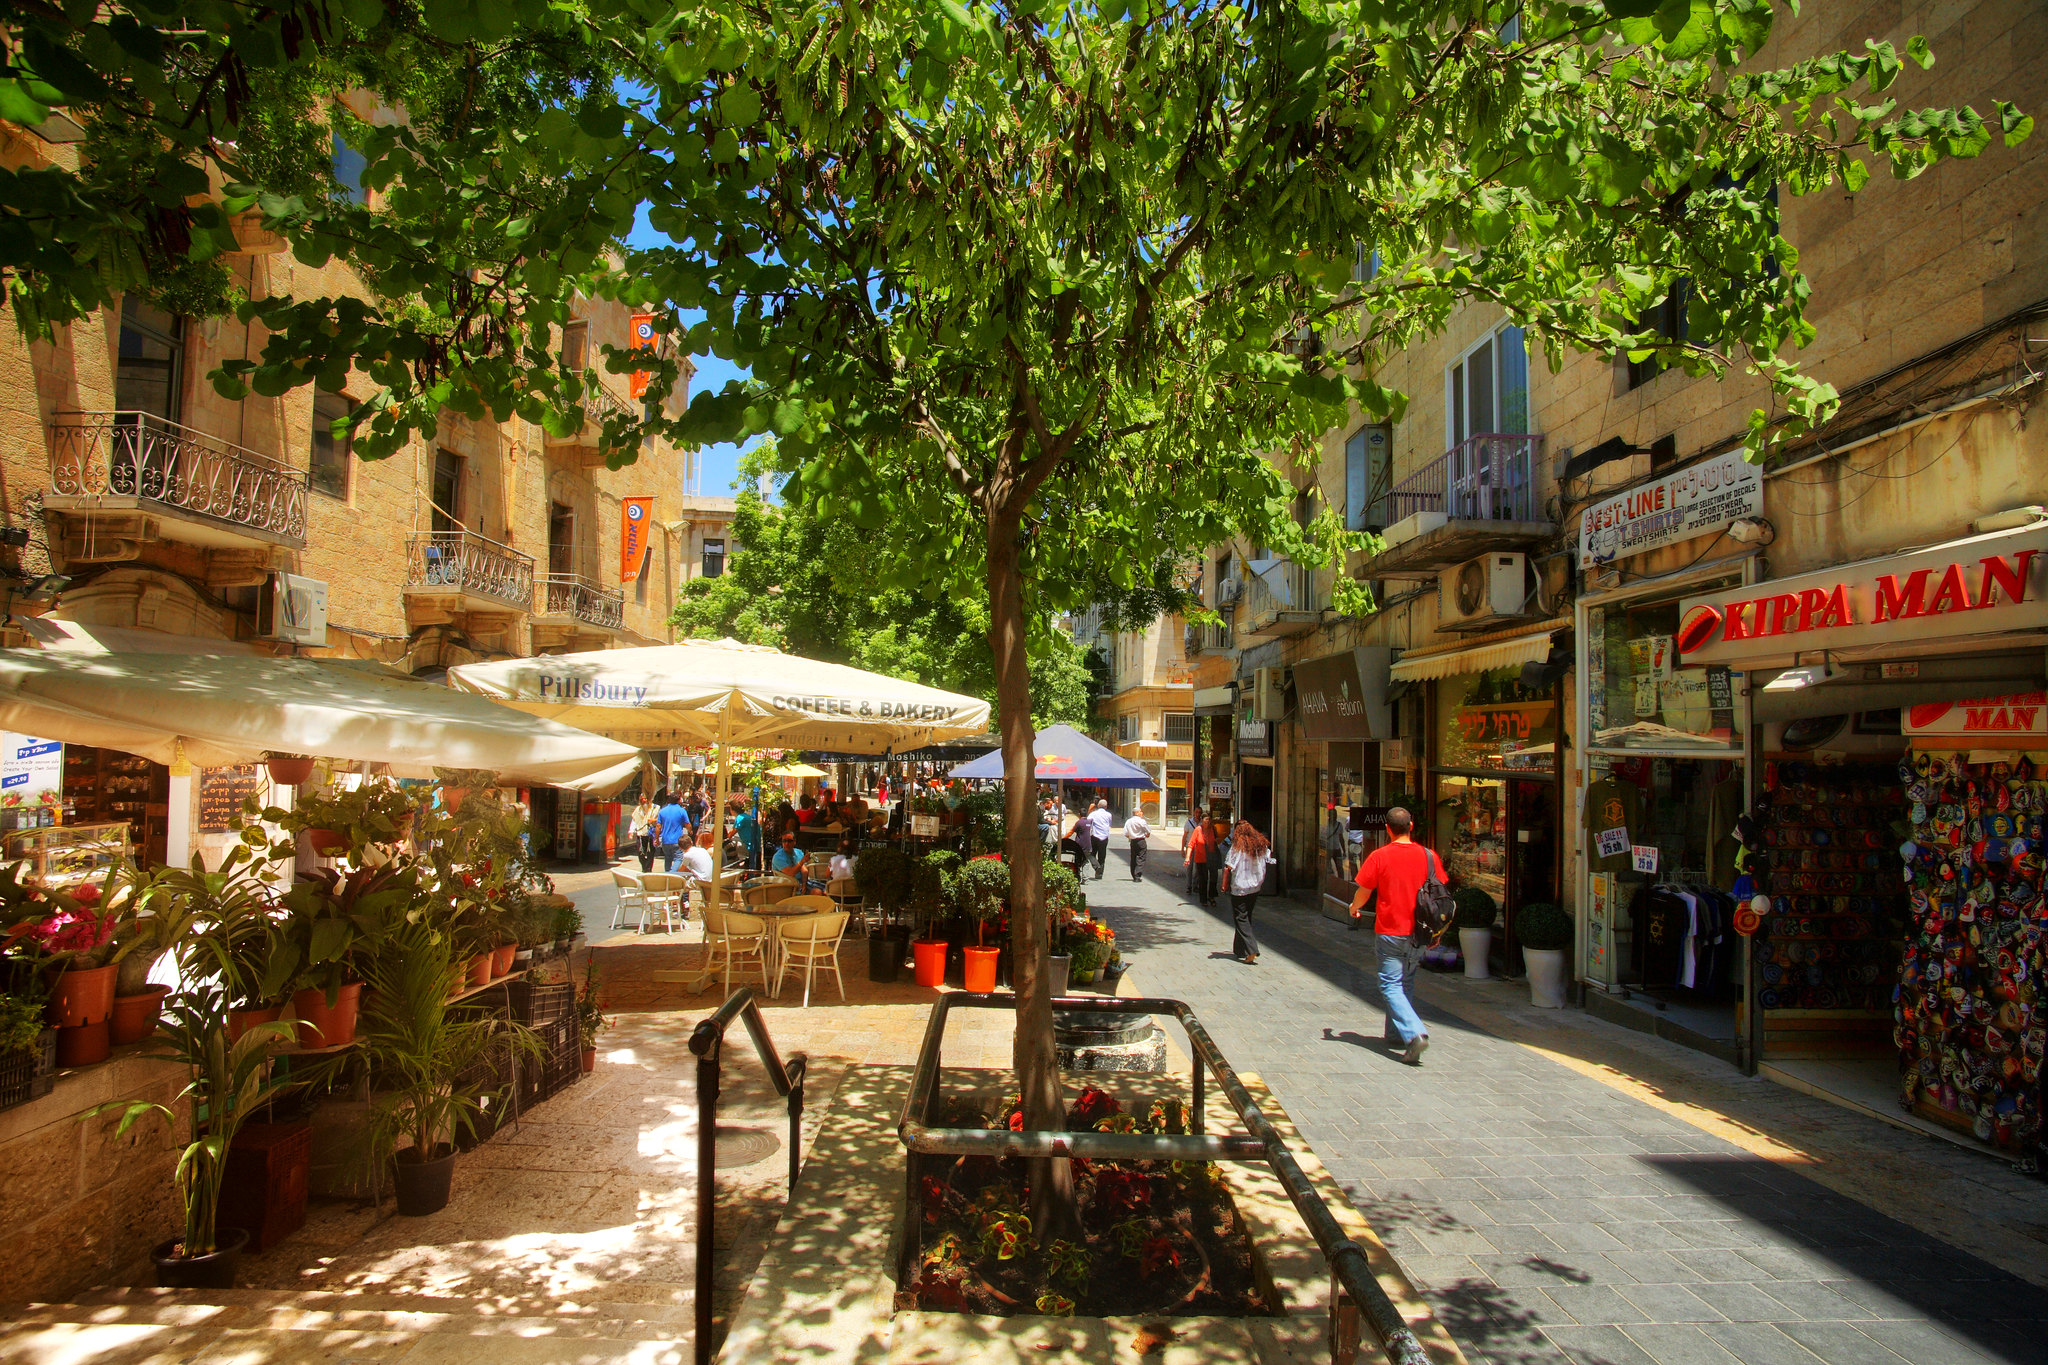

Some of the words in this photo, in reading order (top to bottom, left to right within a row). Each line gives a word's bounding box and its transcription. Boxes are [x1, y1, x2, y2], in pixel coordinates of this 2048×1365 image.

[1699, 494, 1725, 510] SELECTION
[1725, 491, 1733, 501] OF
[1733, 483, 1757, 498] DECALS
[1699, 497, 1744, 518] SPORTSWEAR
[1724, 501, 1752, 519] הלבשה
[1621, 525, 1679, 549] SWEATSHIRTS
[1721, 583, 1853, 642] KIPPA
[1870, 550, 2039, 625] MAN
[539, 675, 648, 705] Pillsbury
[772, 695, 852, 715] COFFEE
[859, 700, 873, 716] &
[880, 701, 959, 720] BAKERY
[1302, 691, 1328, 715] AHAVA
[1492, 711, 1531, 738] פרחי
[1963, 707, 2039, 731] MAN
[887, 752, 933, 761] Moshiko
[1141, 746, 1170, 757] IRAN
[1212, 786, 1229, 794] HSI
[1604, 831, 1616, 842] SALE
[1602, 844, 1612, 855] 25
[1613, 841, 1622, 853] sh
[1641, 847, 1651, 858] SALE
[1638, 859, 1646, 870] 25
[1646, 860, 1653, 870] sh
